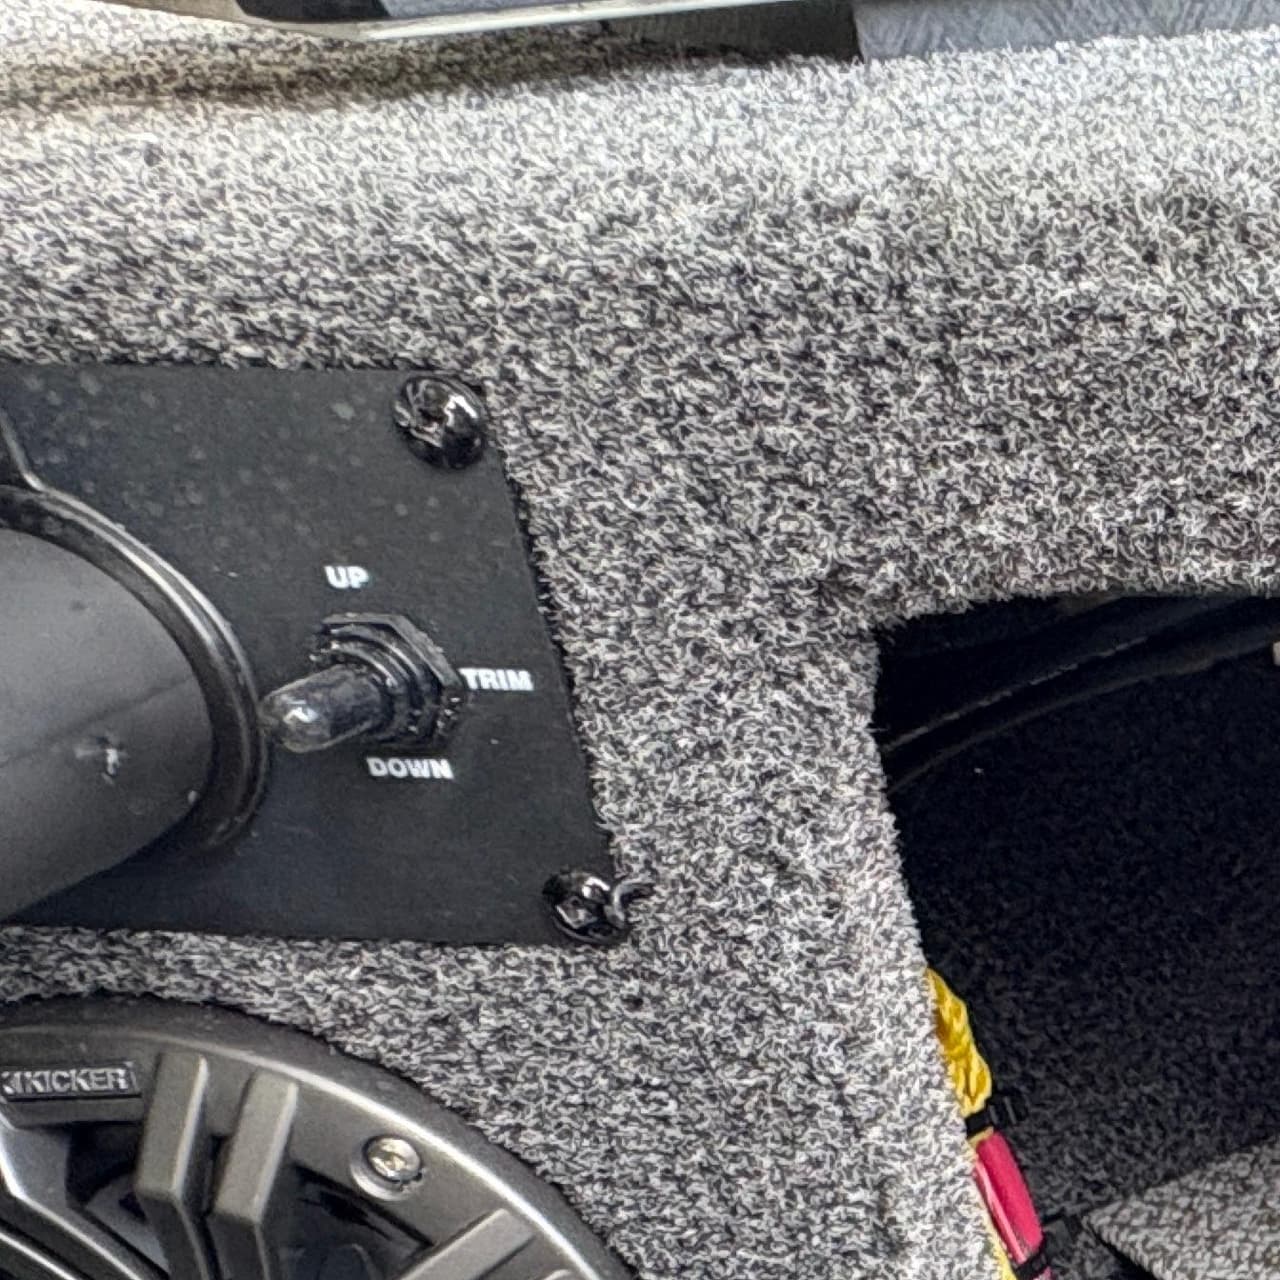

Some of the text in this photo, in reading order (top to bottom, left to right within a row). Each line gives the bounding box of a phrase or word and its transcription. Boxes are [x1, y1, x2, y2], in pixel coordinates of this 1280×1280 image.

[324, 565, 369, 589] UP
[458, 667, 535, 692] TRIM
[366, 756, 455, 780] DOWN
[24, 1068, 128, 1094] KICKER
